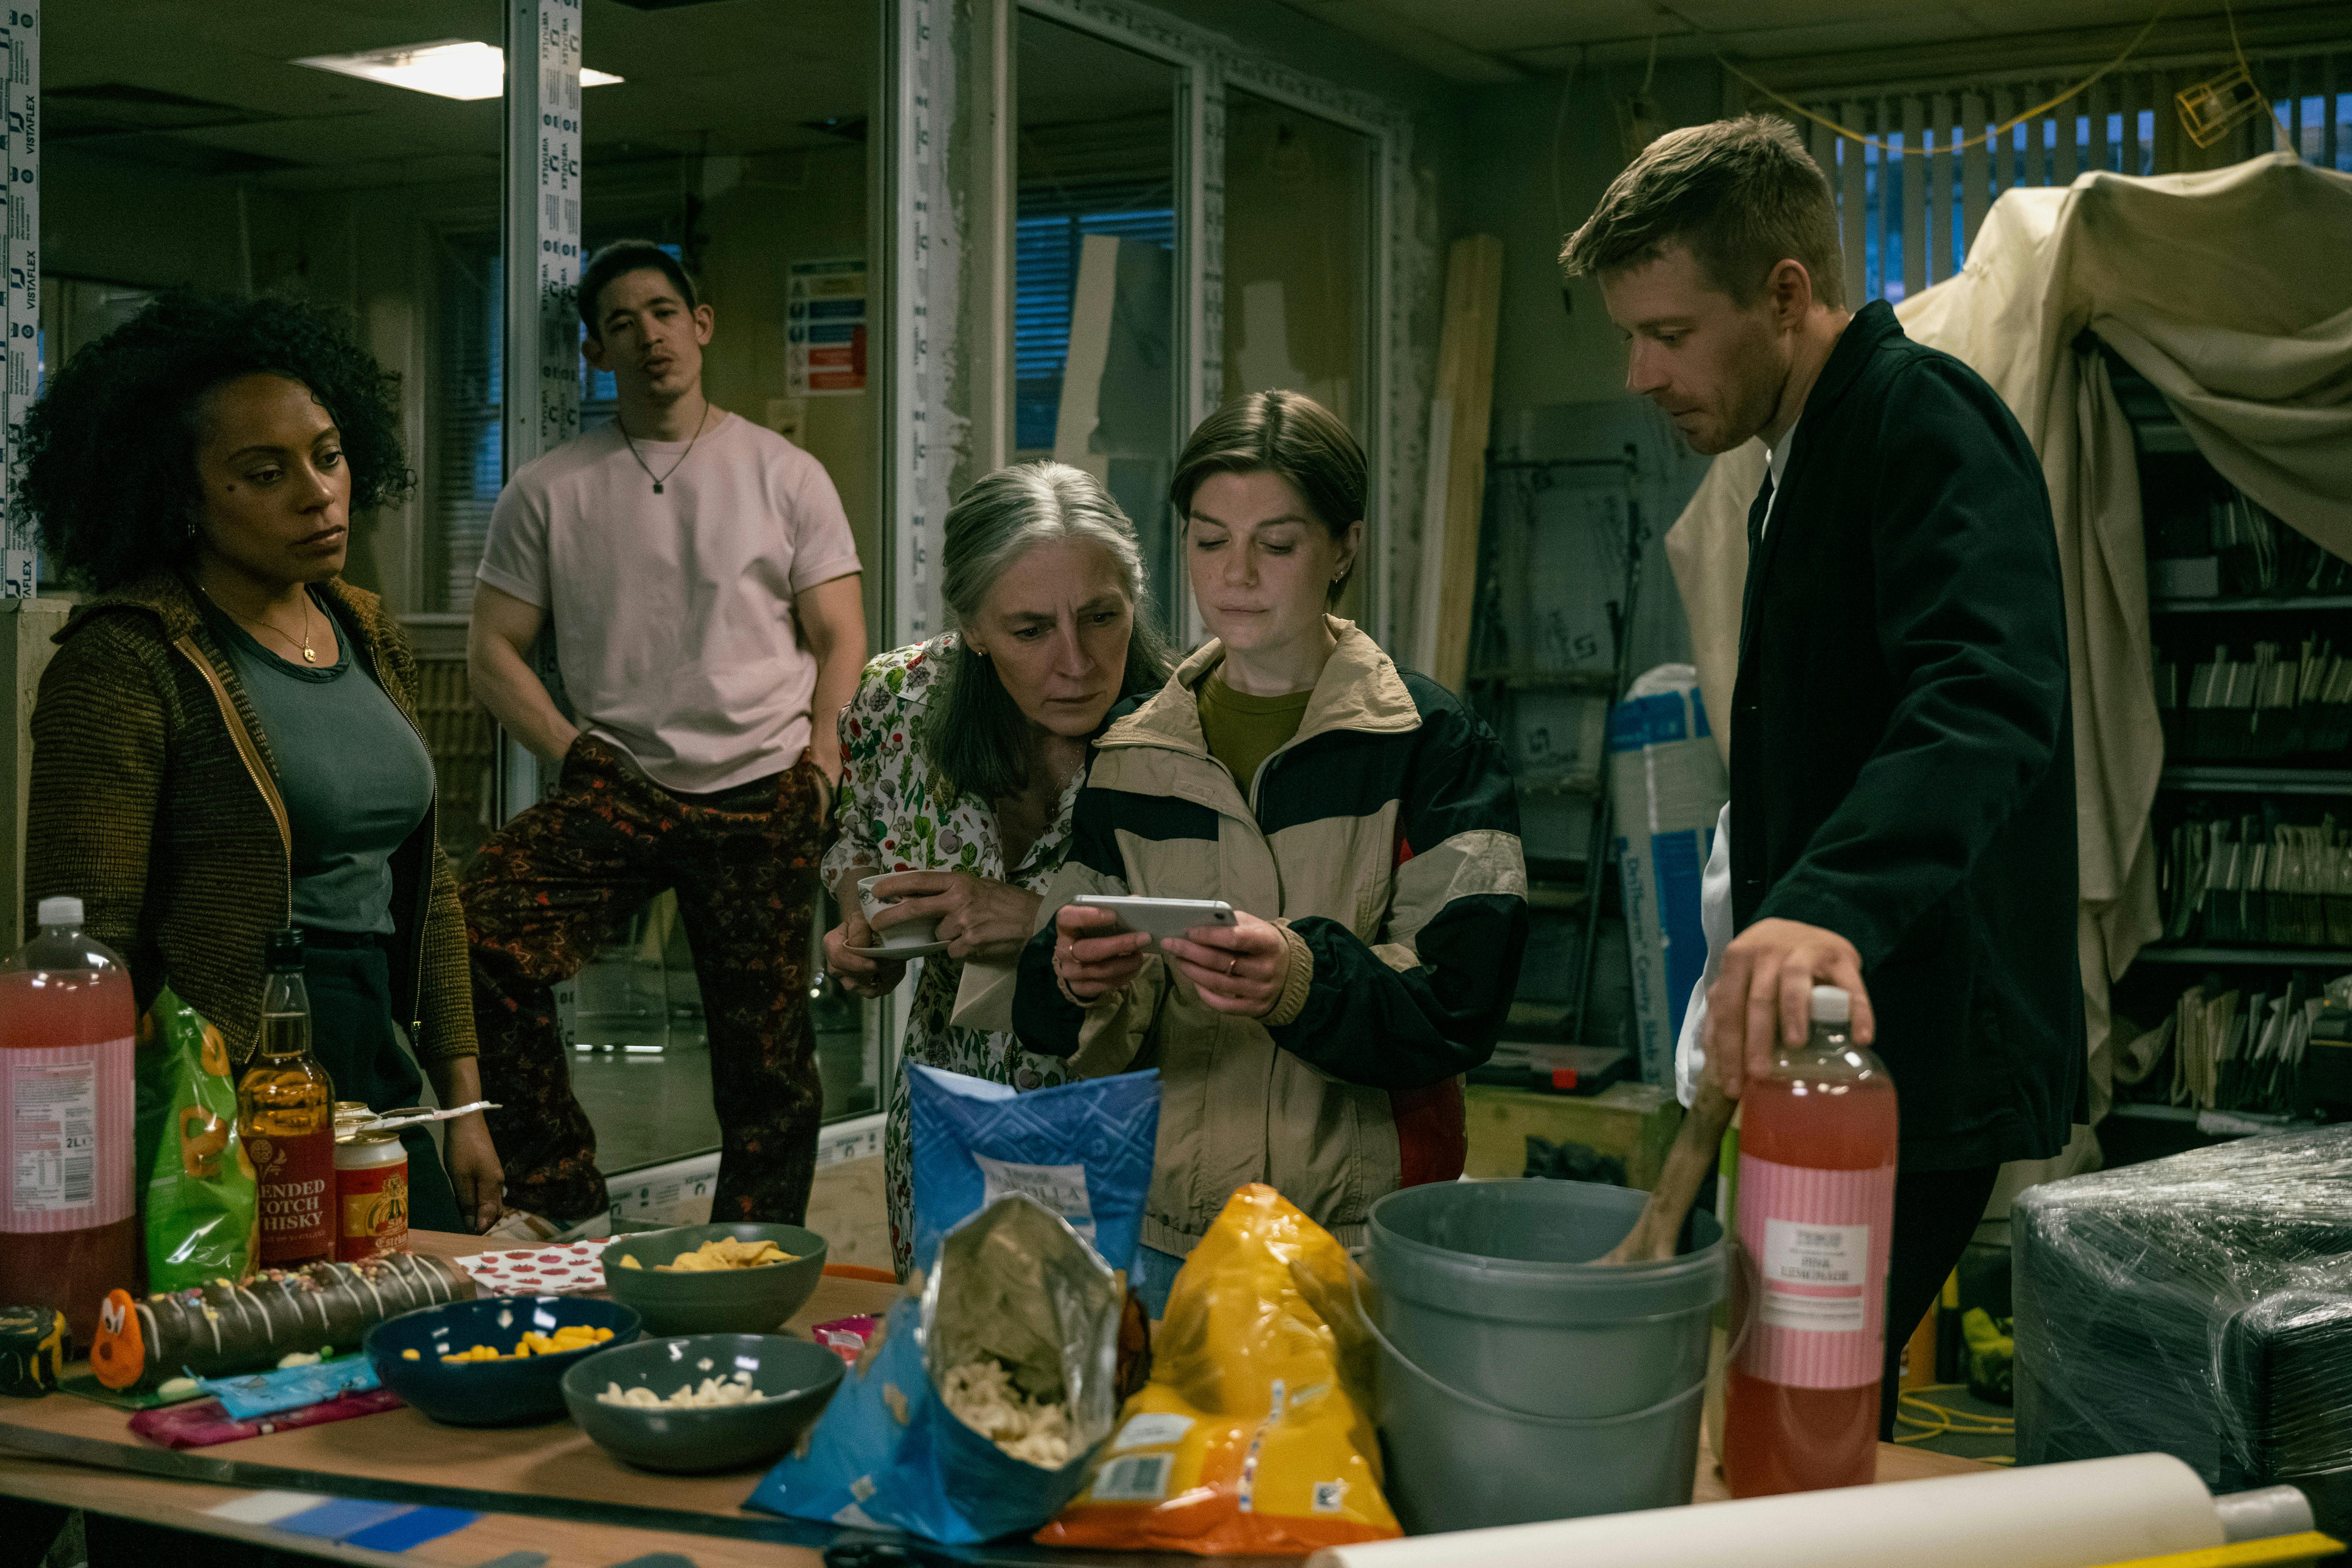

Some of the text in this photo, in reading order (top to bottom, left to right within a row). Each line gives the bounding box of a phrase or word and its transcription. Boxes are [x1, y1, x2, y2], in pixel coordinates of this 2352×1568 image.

[26, 95, 35, 155] VISTAFLEX
[27, 250, 36, 309] VISTAFLEX
[23, 561, 32, 599] TAFLEX
[261, 1179, 325, 1197] ENDED
[263, 1196, 319, 1214] OTCH
[261, 1211, 323, 1231] HISKY
